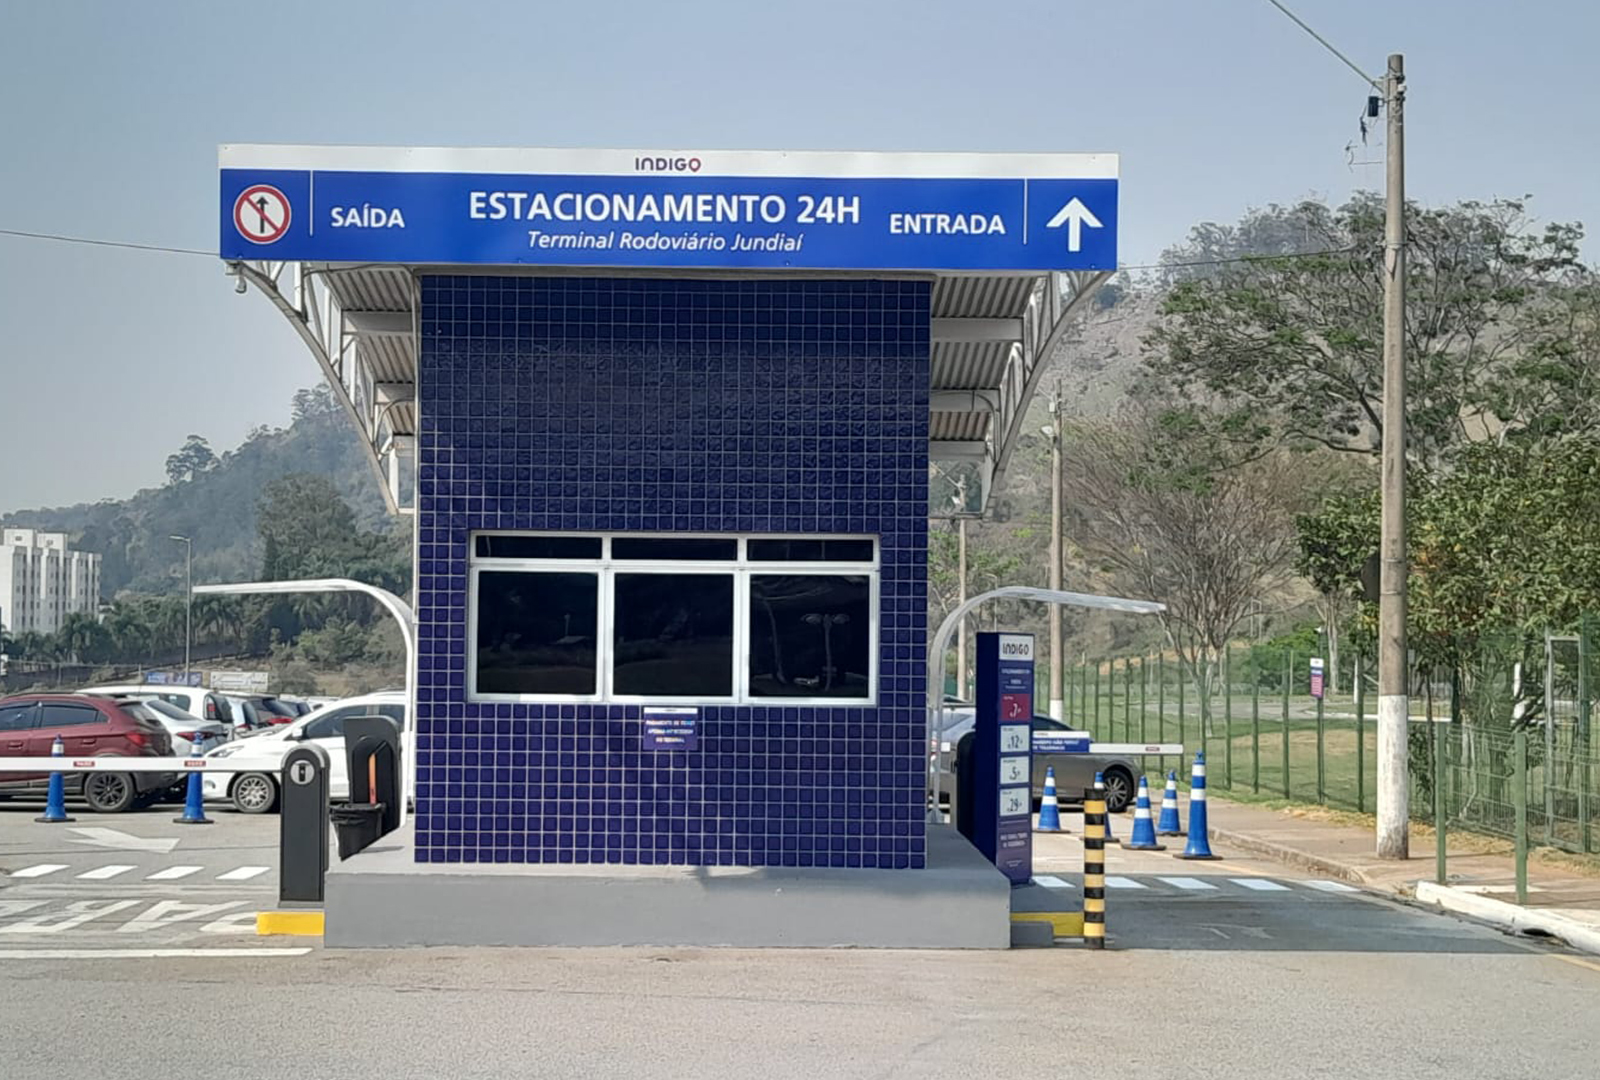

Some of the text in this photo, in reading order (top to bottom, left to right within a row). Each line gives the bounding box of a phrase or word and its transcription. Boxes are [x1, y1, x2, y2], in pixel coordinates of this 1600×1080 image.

[635, 157, 702, 172] INDIGO
[330, 204, 406, 229] SAÍDA
[469, 190, 860, 224] ESTACIONAMENTO 24H
[889, 212, 1006, 236] ENTRADA
[528, 230, 805, 252] Terminal Rodoviário Jundiaí
[1002, 643, 1030, 656] INDIGO
